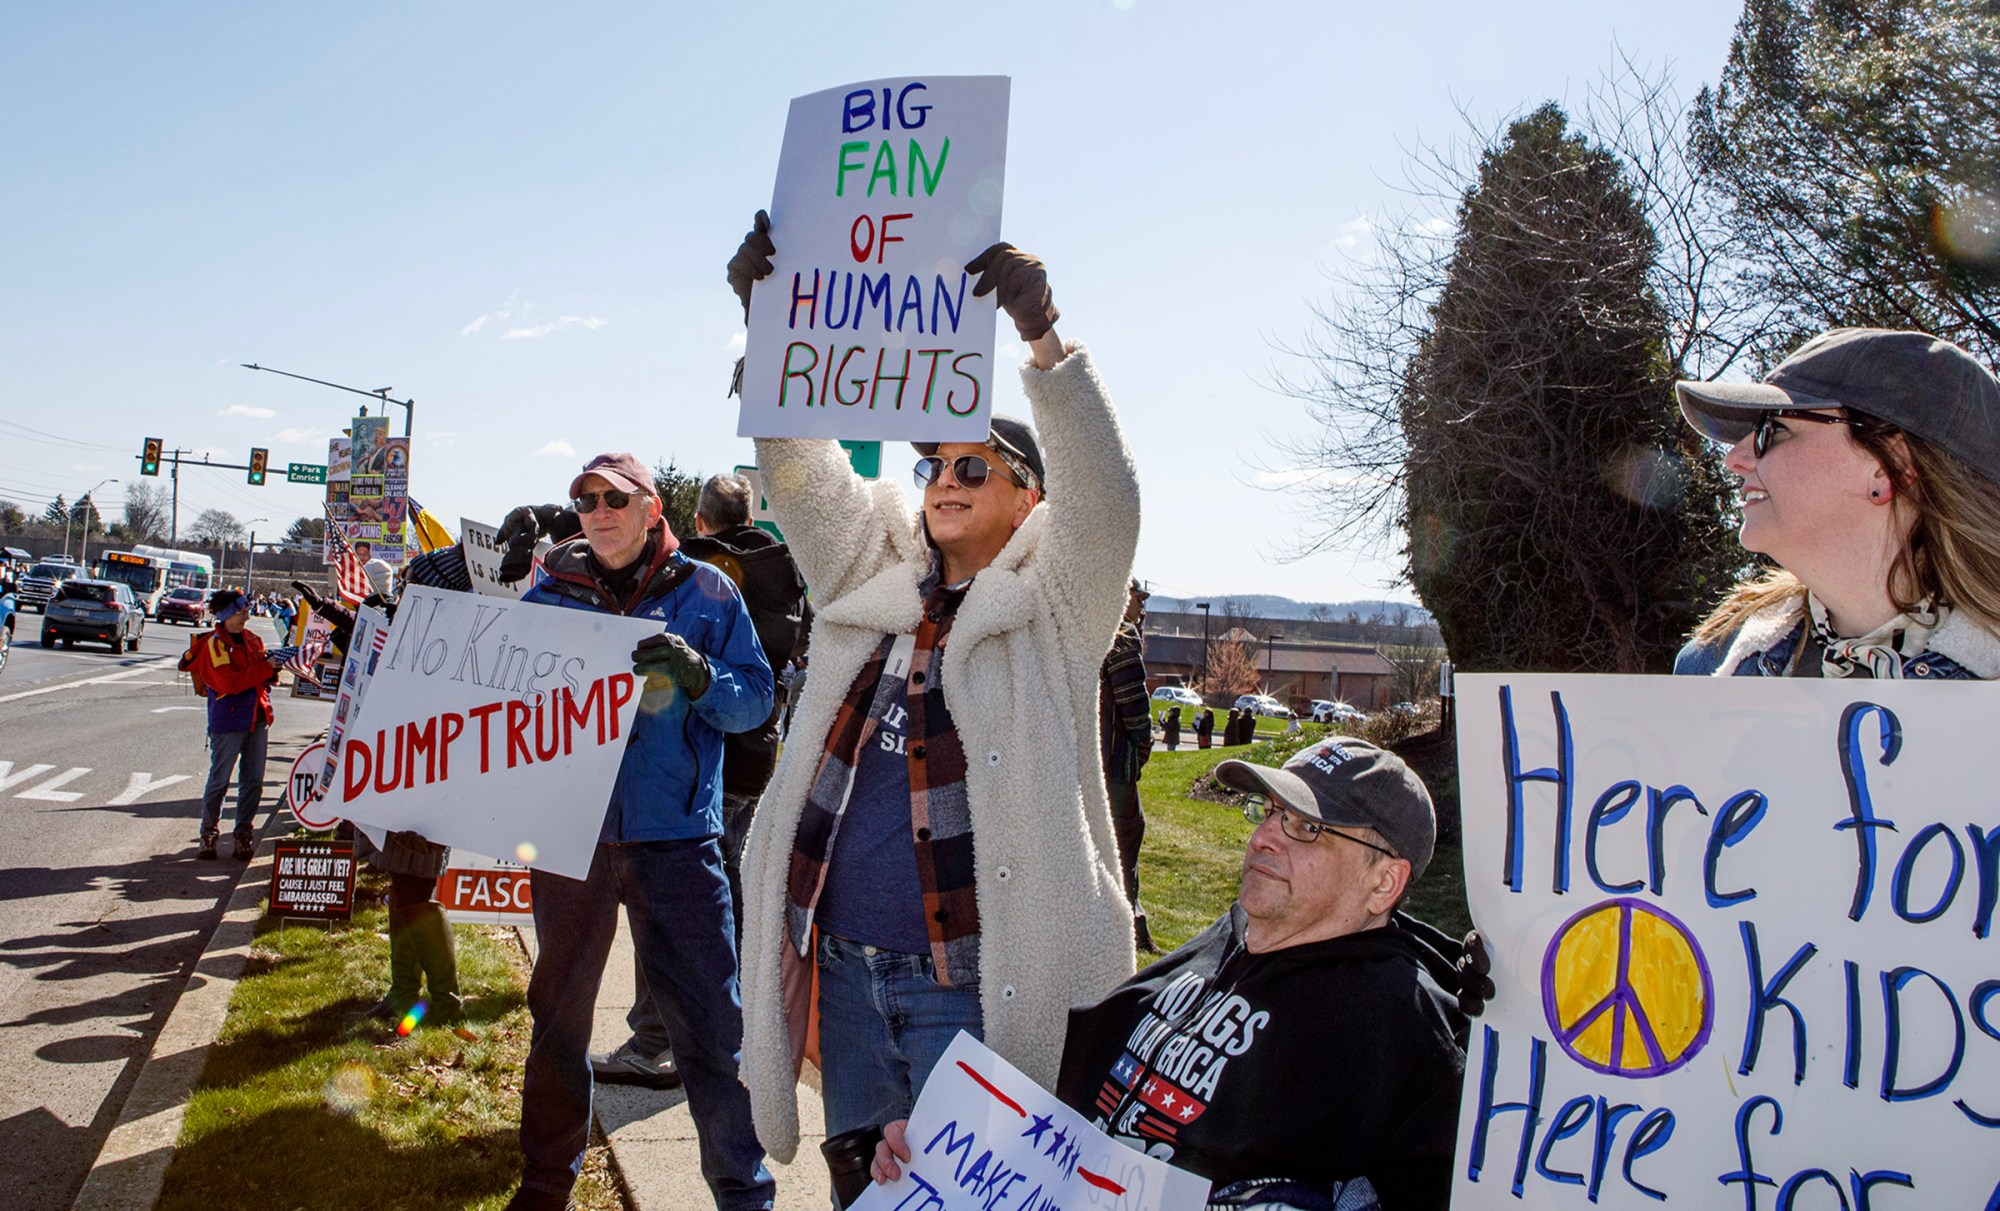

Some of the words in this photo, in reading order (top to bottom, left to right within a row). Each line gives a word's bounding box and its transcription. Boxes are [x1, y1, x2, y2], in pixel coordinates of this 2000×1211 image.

[842, 82, 933, 134] BIG
[836, 136, 950, 198] FAN
[850, 213, 914, 264] OF
[788, 268, 968, 336] HUMAN
[778, 341, 983, 418] RIGHTS
[290, 472, 321, 482] Emrick
[301, 465, 321, 474] Park
[361, 525, 381, 538] KING
[383, 497, 407, 517] 47
[471, 560, 484, 579] IS
[386, 595, 449, 676] No
[450, 604, 586, 709] Kings
[343, 712, 465, 803] DUMP
[469, 672, 634, 774] TRUMP
[1499, 684, 1769, 908] Here
[1832, 700, 2000, 939] for
[278, 857, 294, 875] ARE
[294, 857, 307, 876] WE
[307, 858, 333, 876] GREAT
[333, 858, 351, 877] YET?
[279, 879, 303, 890] CAUSE
[308, 880, 328, 891] JUST
[328, 880, 345, 892] FEEL
[278, 891, 344, 904] EMBARRASSED...
[1153, 970, 1205, 1021] NO
[1467, 1023, 1676, 1204] Here
[924, 1119, 1027, 1211] MAKE
